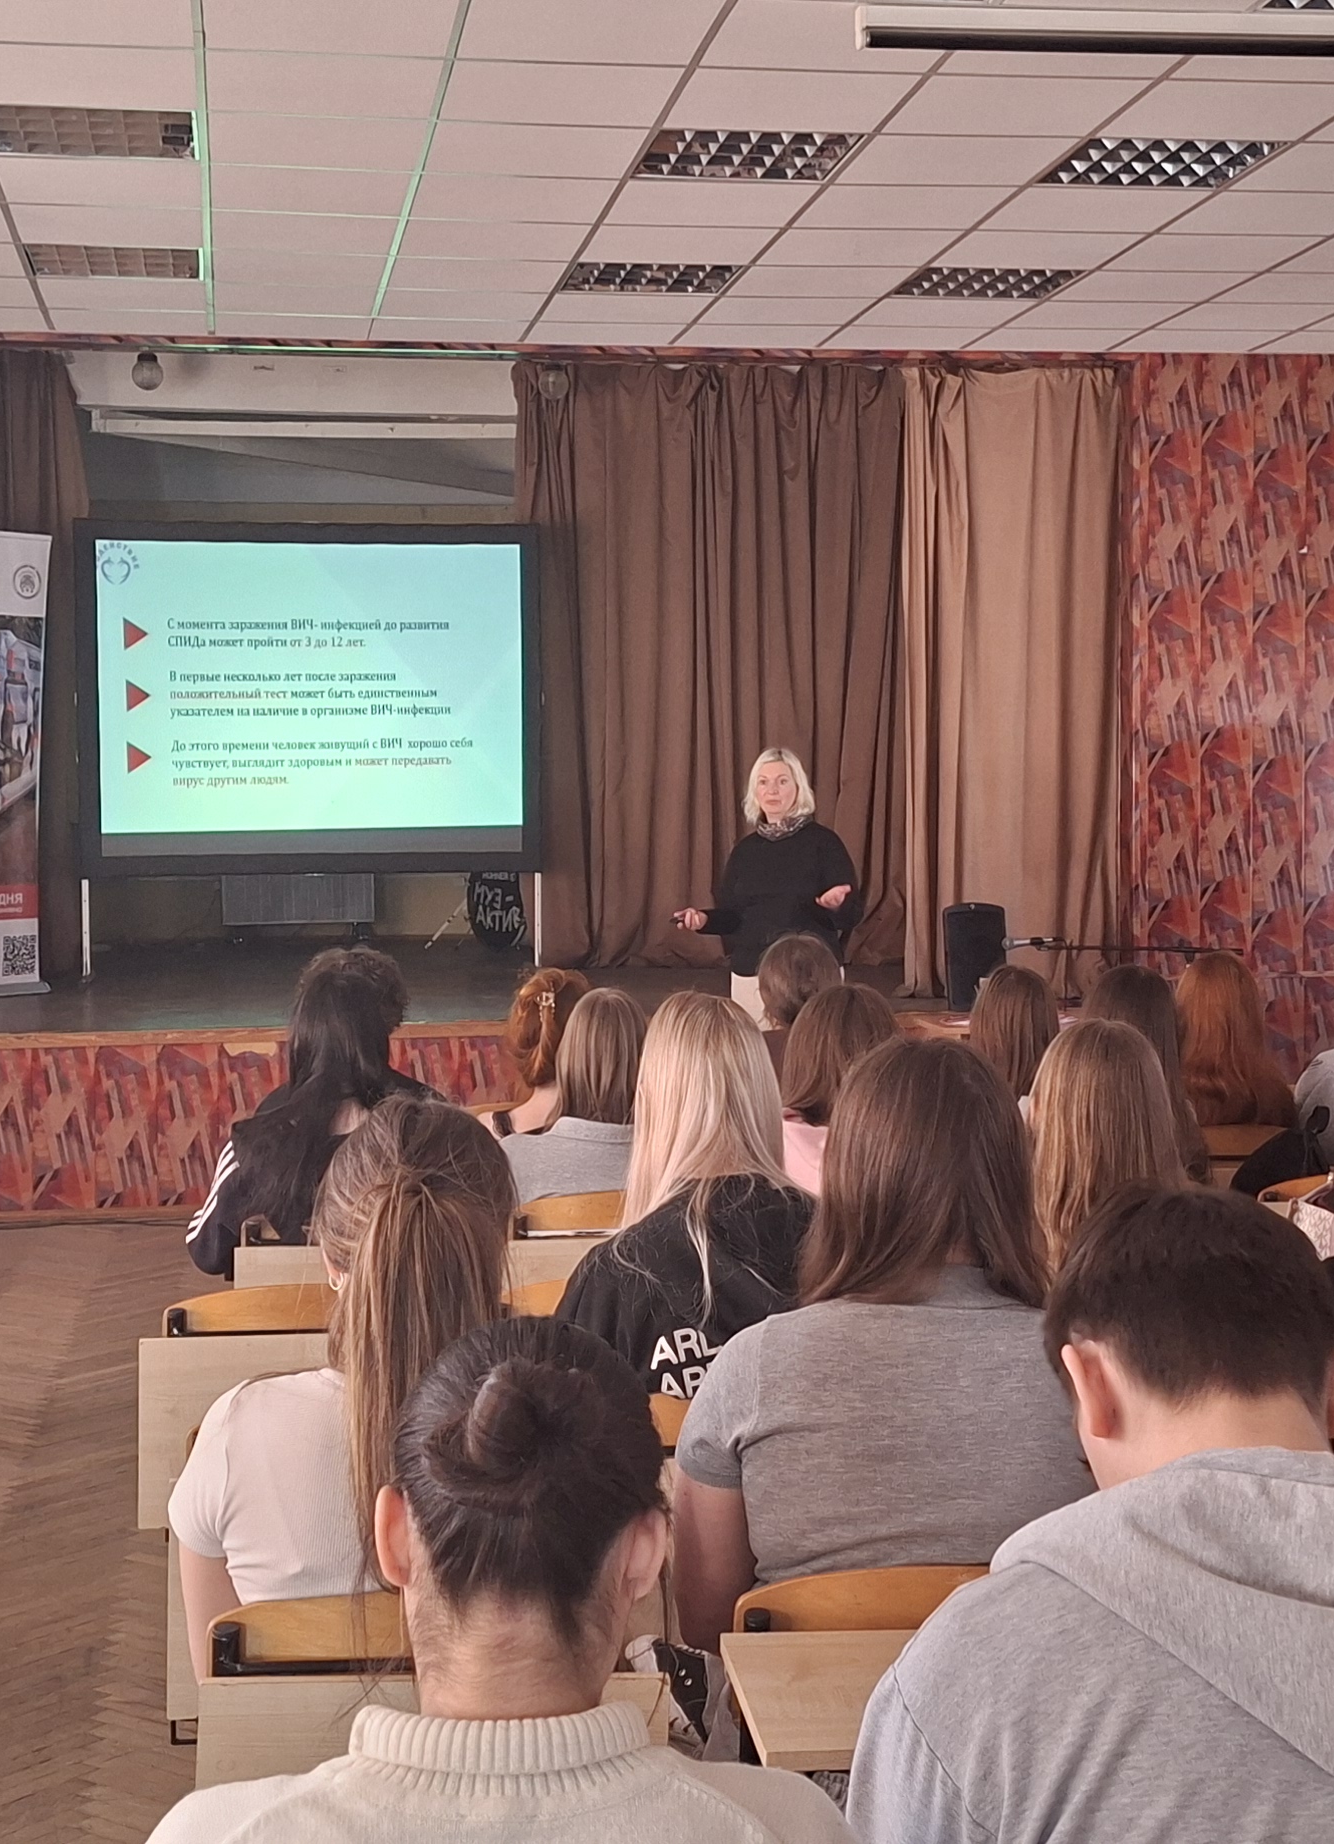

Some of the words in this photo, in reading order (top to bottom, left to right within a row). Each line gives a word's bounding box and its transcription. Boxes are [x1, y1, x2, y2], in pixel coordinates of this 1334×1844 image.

[167, 617, 175, 630] С
[177, 620, 226, 630] момента
[228, 620, 288, 632] заражения
[320, 618, 381, 633] инфекцией
[383, 621, 397, 631] до
[399, 621, 450, 633] развития
[168, 635, 206, 649] СПИДа
[208, 638, 244, 648] может
[247, 636, 287, 650] пройти
[290, 638, 302, 647] от
[305, 636, 312, 647] 3
[314, 638, 327, 648] до
[331, 636, 343, 647] 12
[345, 638, 367, 647] лет.
[169, 670, 177, 682] В
[180, 672, 221, 685] первые
[223, 672, 281, 682] несколько
[283, 672, 302, 682] лет
[305, 672, 336, 682] после
[338, 672, 397, 684] заражения
[170, 688, 261, 700] положительный
[264, 689, 288, 699] тест
[290, 689, 326, 699] может
[328, 687, 355, 699] быть
[358, 688, 438, 700] единственным
[170, 707, 234, 719] указателем
[237, 707, 250, 716] на
[252, 707, 299, 716] наличие
[302, 707, 308, 716] в
[310, 706, 368, 718] организме
[370, 703, 451, 718] ВИЧ-инфекции
[171, 739, 186, 753] До
[188, 741, 219, 751] этого
[222, 741, 269, 753] времени
[271, 740, 316, 750] человек
[318, 739, 369, 752] живущий
[372, 740, 378, 749] с
[380, 737, 402, 749] ВИЧ
[407, 739, 448, 751] хорошо
[450, 737, 473, 748] себя
[172, 758, 230, 771] чувствует,
[232, 758, 285, 769] выглядит
[287, 758, 342, 769] здоровым
[345, 758, 352, 767] и
[355, 757, 389, 767] может
[391, 756, 452, 768] передавать
[173, 776, 205, 788] вирус
[207, 776, 247, 788] другим
[249, 775, 289, 786] людям.
